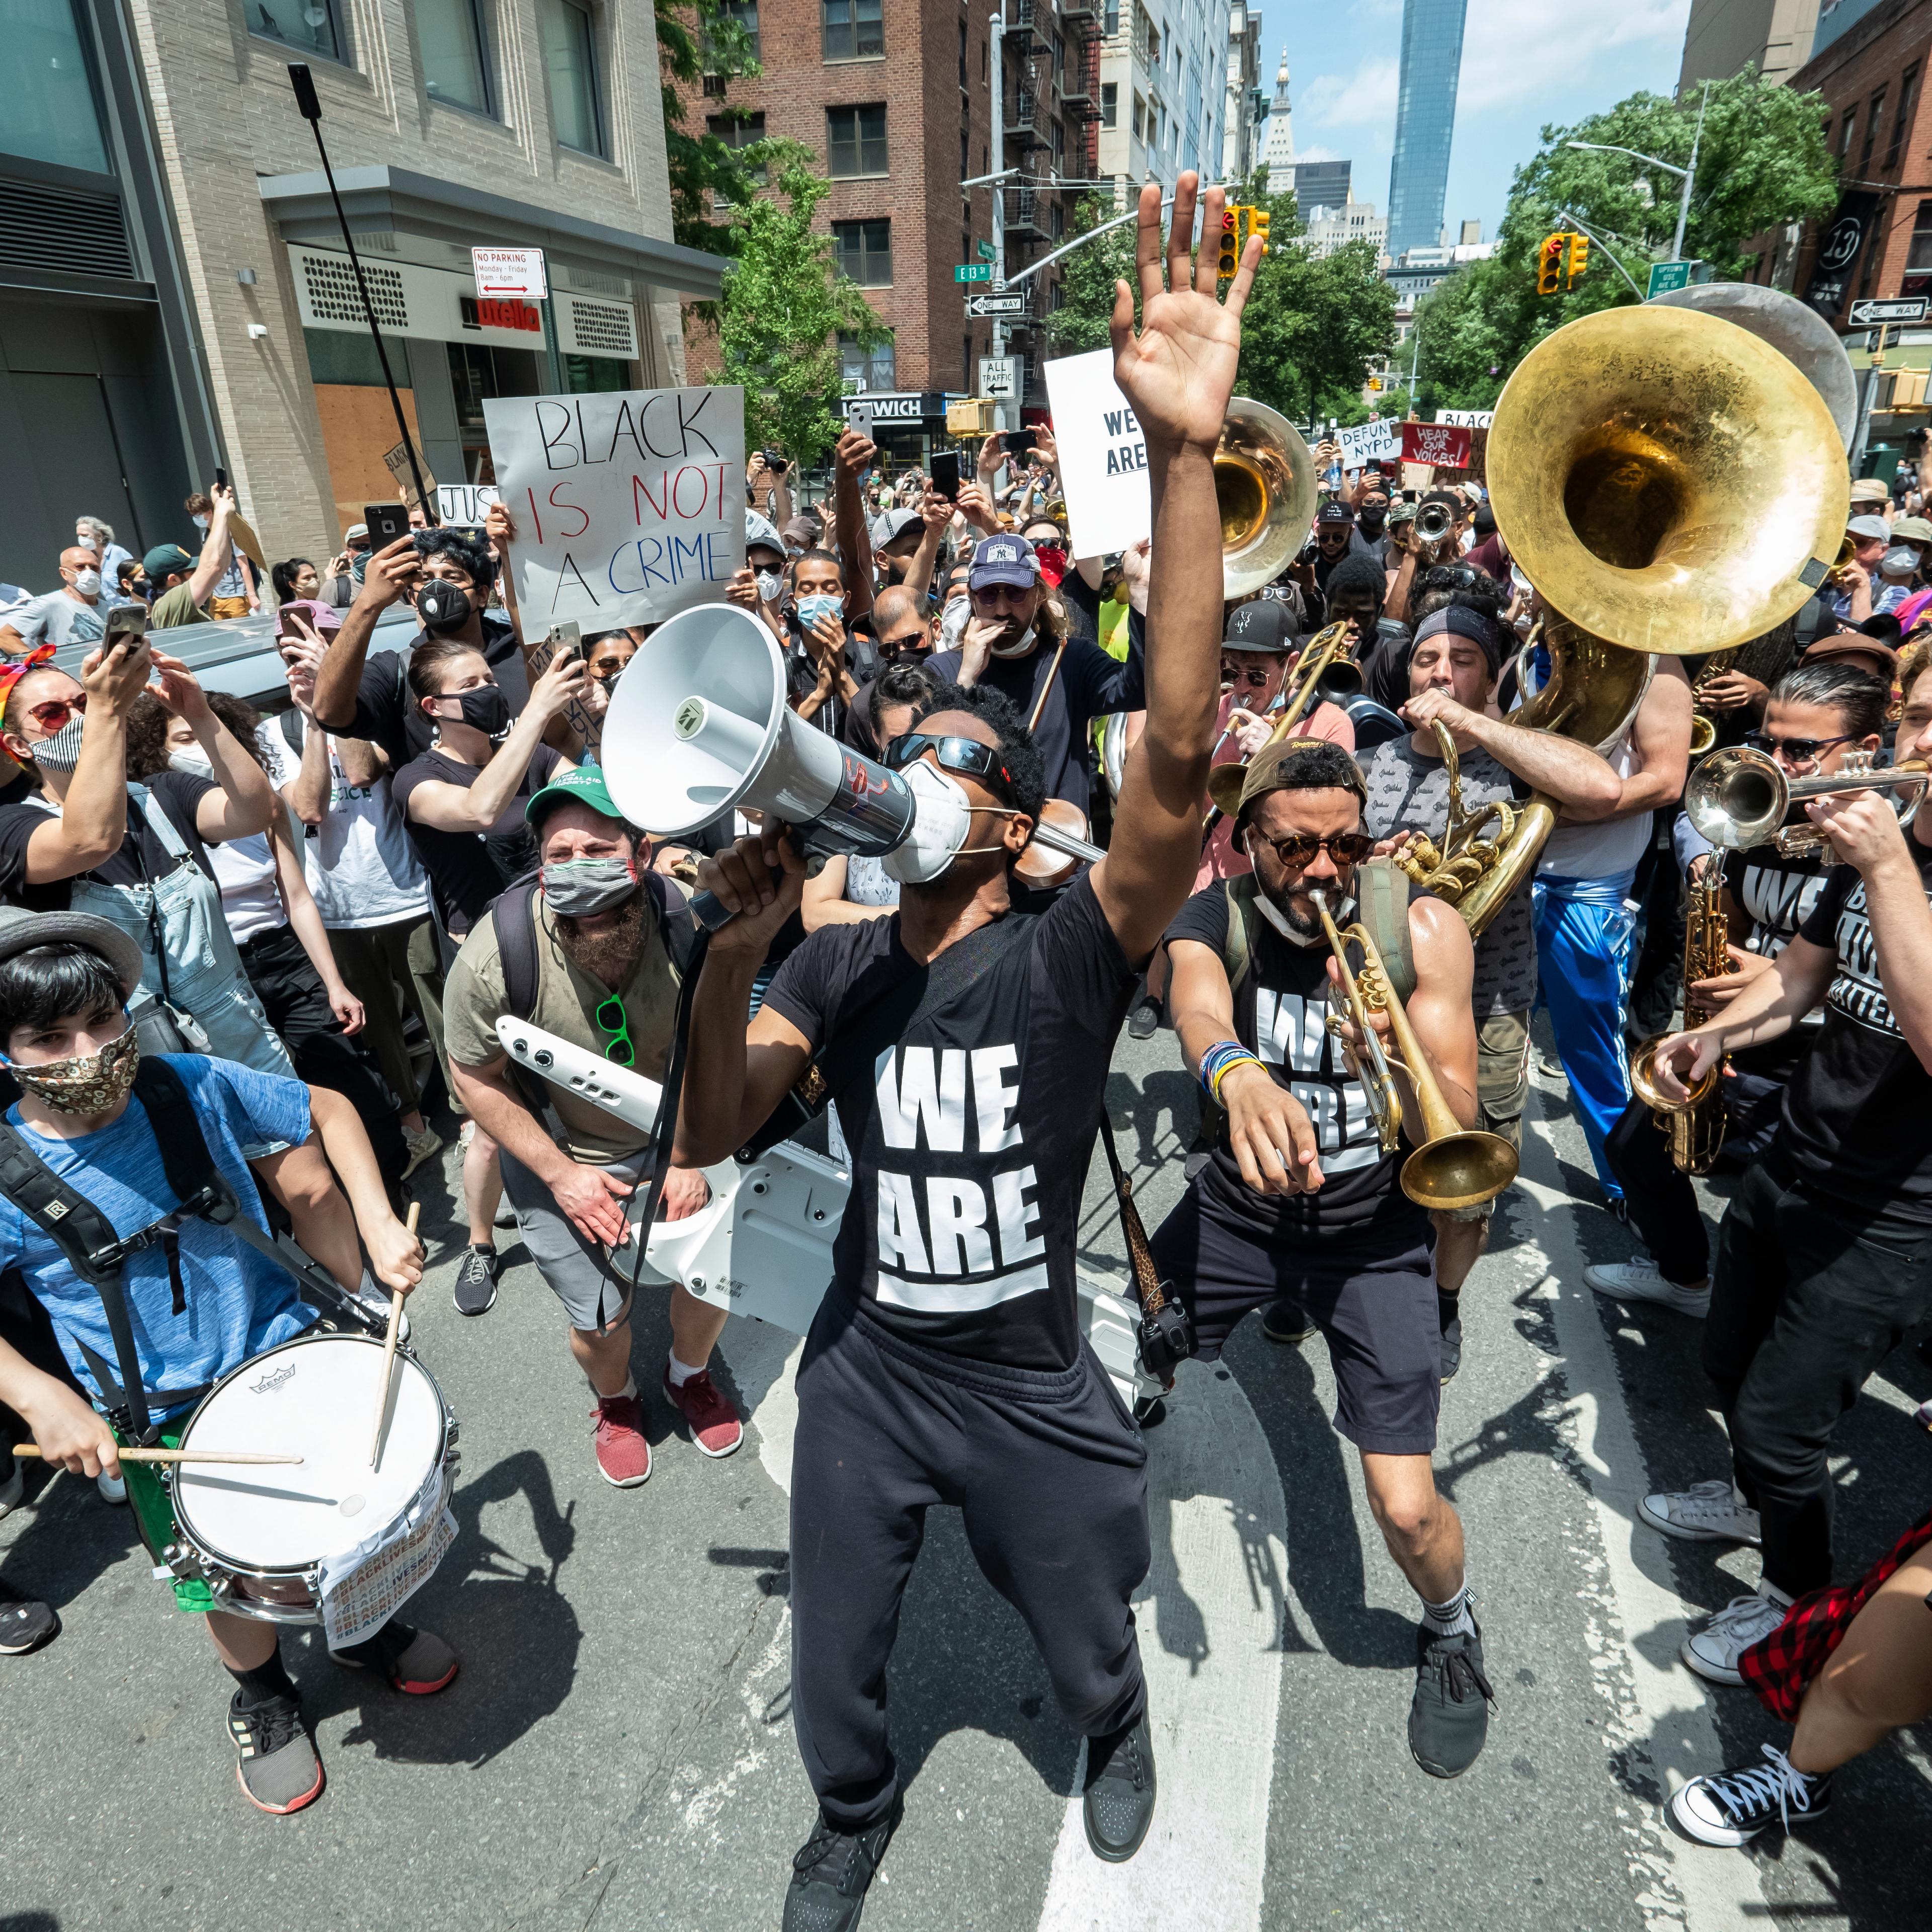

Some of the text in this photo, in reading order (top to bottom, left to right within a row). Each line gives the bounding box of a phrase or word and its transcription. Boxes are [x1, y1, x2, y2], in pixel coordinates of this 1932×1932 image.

[1823, 228, 1856, 259] 13
[477, 254, 526, 263] NO PARKING
[509, 266, 527, 274] Friday
[960, 268, 965, 279] E
[969, 267, 977, 279] 13
[460, 297, 540, 332] nutella
[977, 301, 993, 309] ONE
[1862, 305, 1920, 316] ONE WAY
[982, 373, 1012, 382] TRAFFIC
[987, 362, 1007, 372] ALL
[842, 400, 922, 417] LWICH
[535, 391, 719, 470] BLACK
[1103, 409, 1138, 437] WE
[1416, 428, 1453, 441] HEAR
[1355, 438, 1393, 458] NYPD
[1413, 440, 1465, 467] VOICES!
[1423, 441, 1447, 451] OUR
[1107, 443, 1147, 474] ARE
[440, 486, 497, 524] JUS
[527, 462, 734, 544] IS NOT
[551, 531, 732, 615] A CRIME
[875, 1043, 1023, 1153] WE
[1291, 1081, 1379, 1149] RE
[877, 1164, 1045, 1275] ARE
[258, 1371, 291, 1391] REMO
